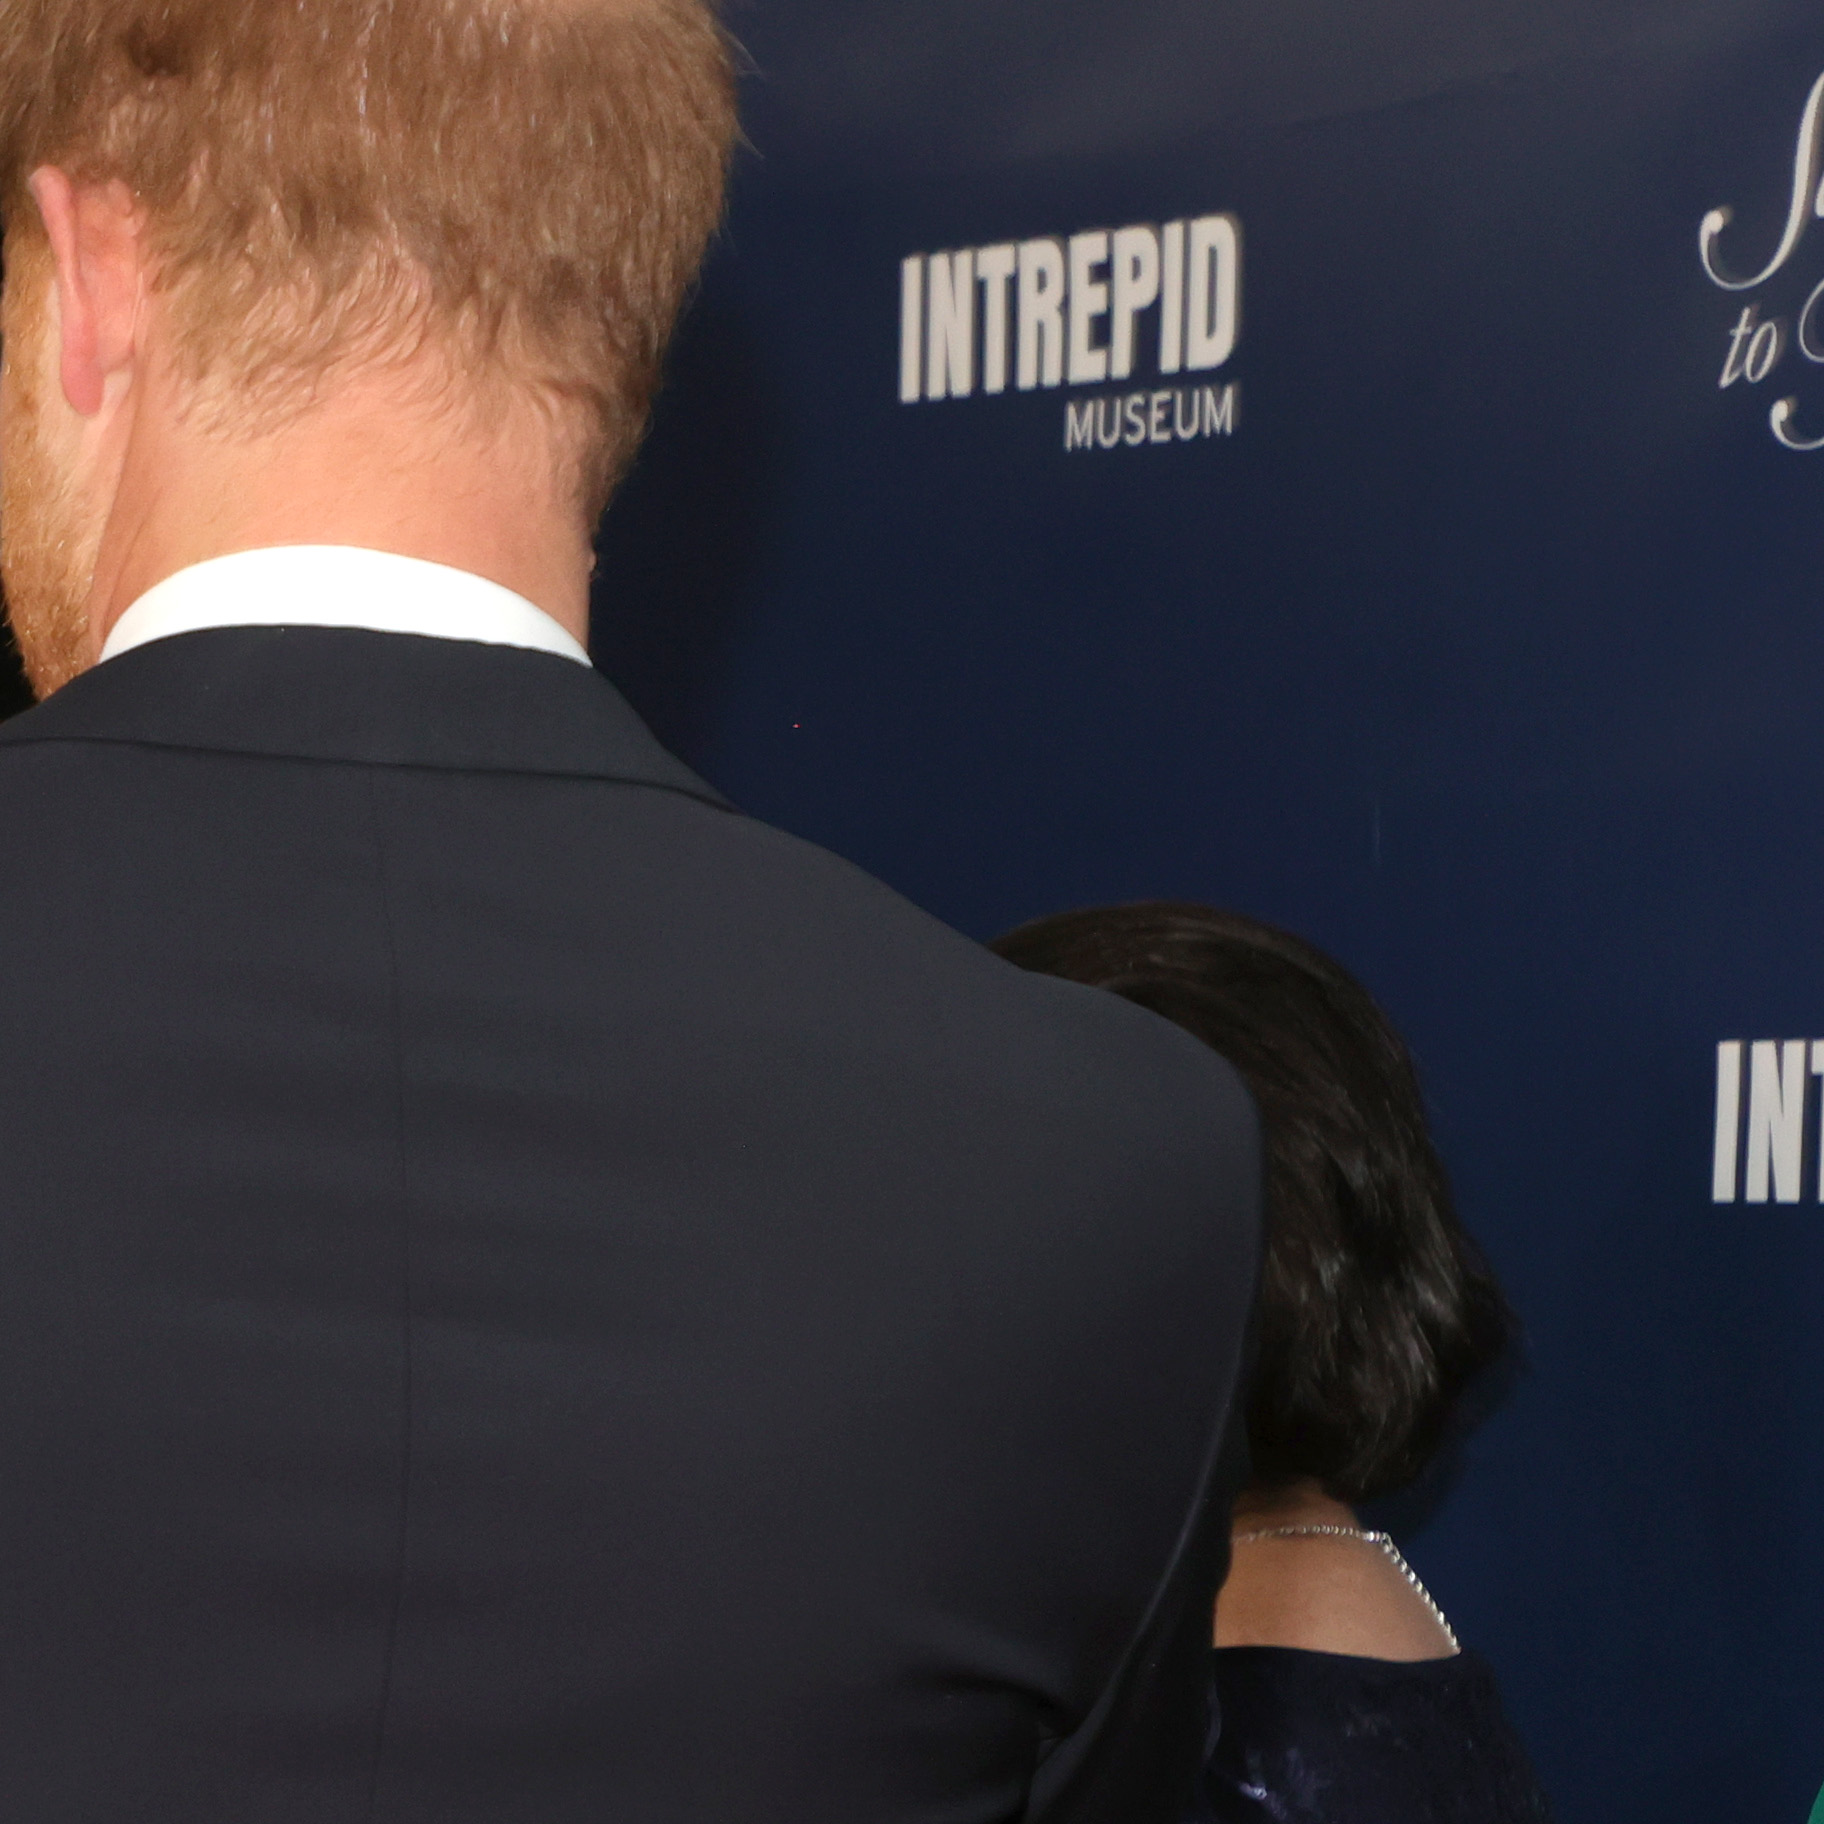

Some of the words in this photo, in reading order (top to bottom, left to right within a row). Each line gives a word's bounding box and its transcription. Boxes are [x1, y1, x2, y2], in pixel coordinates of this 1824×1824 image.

[899, 214, 1241, 403] INTREPID
[1718, 306, 1779, 389] to
[1064, 385, 1235, 451] MUSEUM
